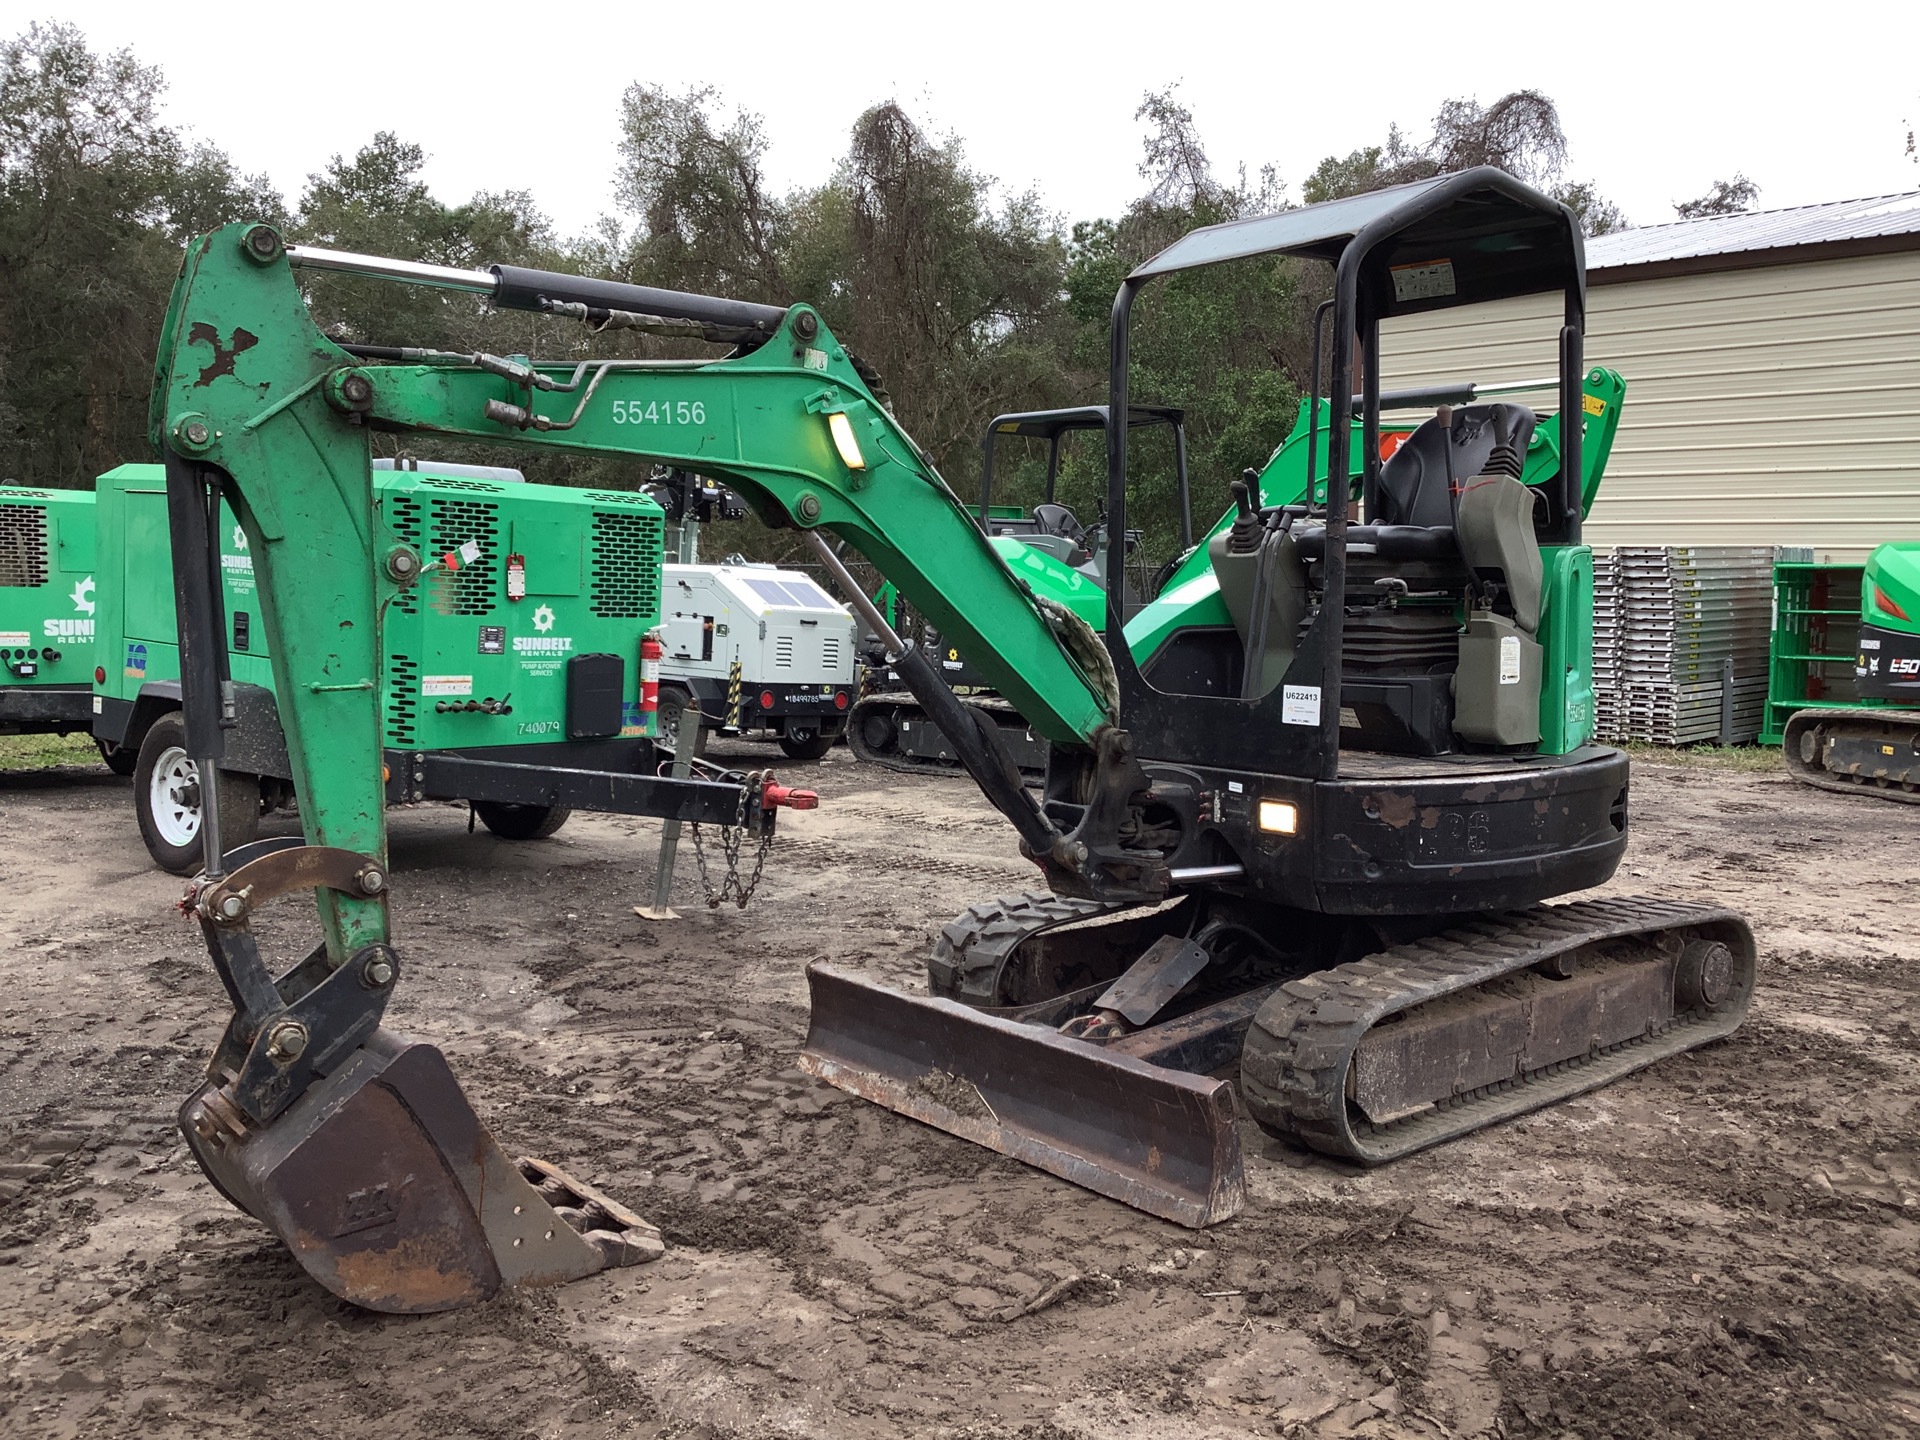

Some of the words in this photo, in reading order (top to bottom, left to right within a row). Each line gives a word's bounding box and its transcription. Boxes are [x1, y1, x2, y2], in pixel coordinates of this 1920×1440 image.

[612, 400, 706, 425] 554156
[512, 637, 571, 651] SUNBELT
[529, 669, 553, 677] SERVICES
[1889, 658, 1920, 674] E50
[1285, 691, 1318, 702] U622413
[518, 721, 560, 735] 740079
[621, 726, 647, 736] YSTEM
